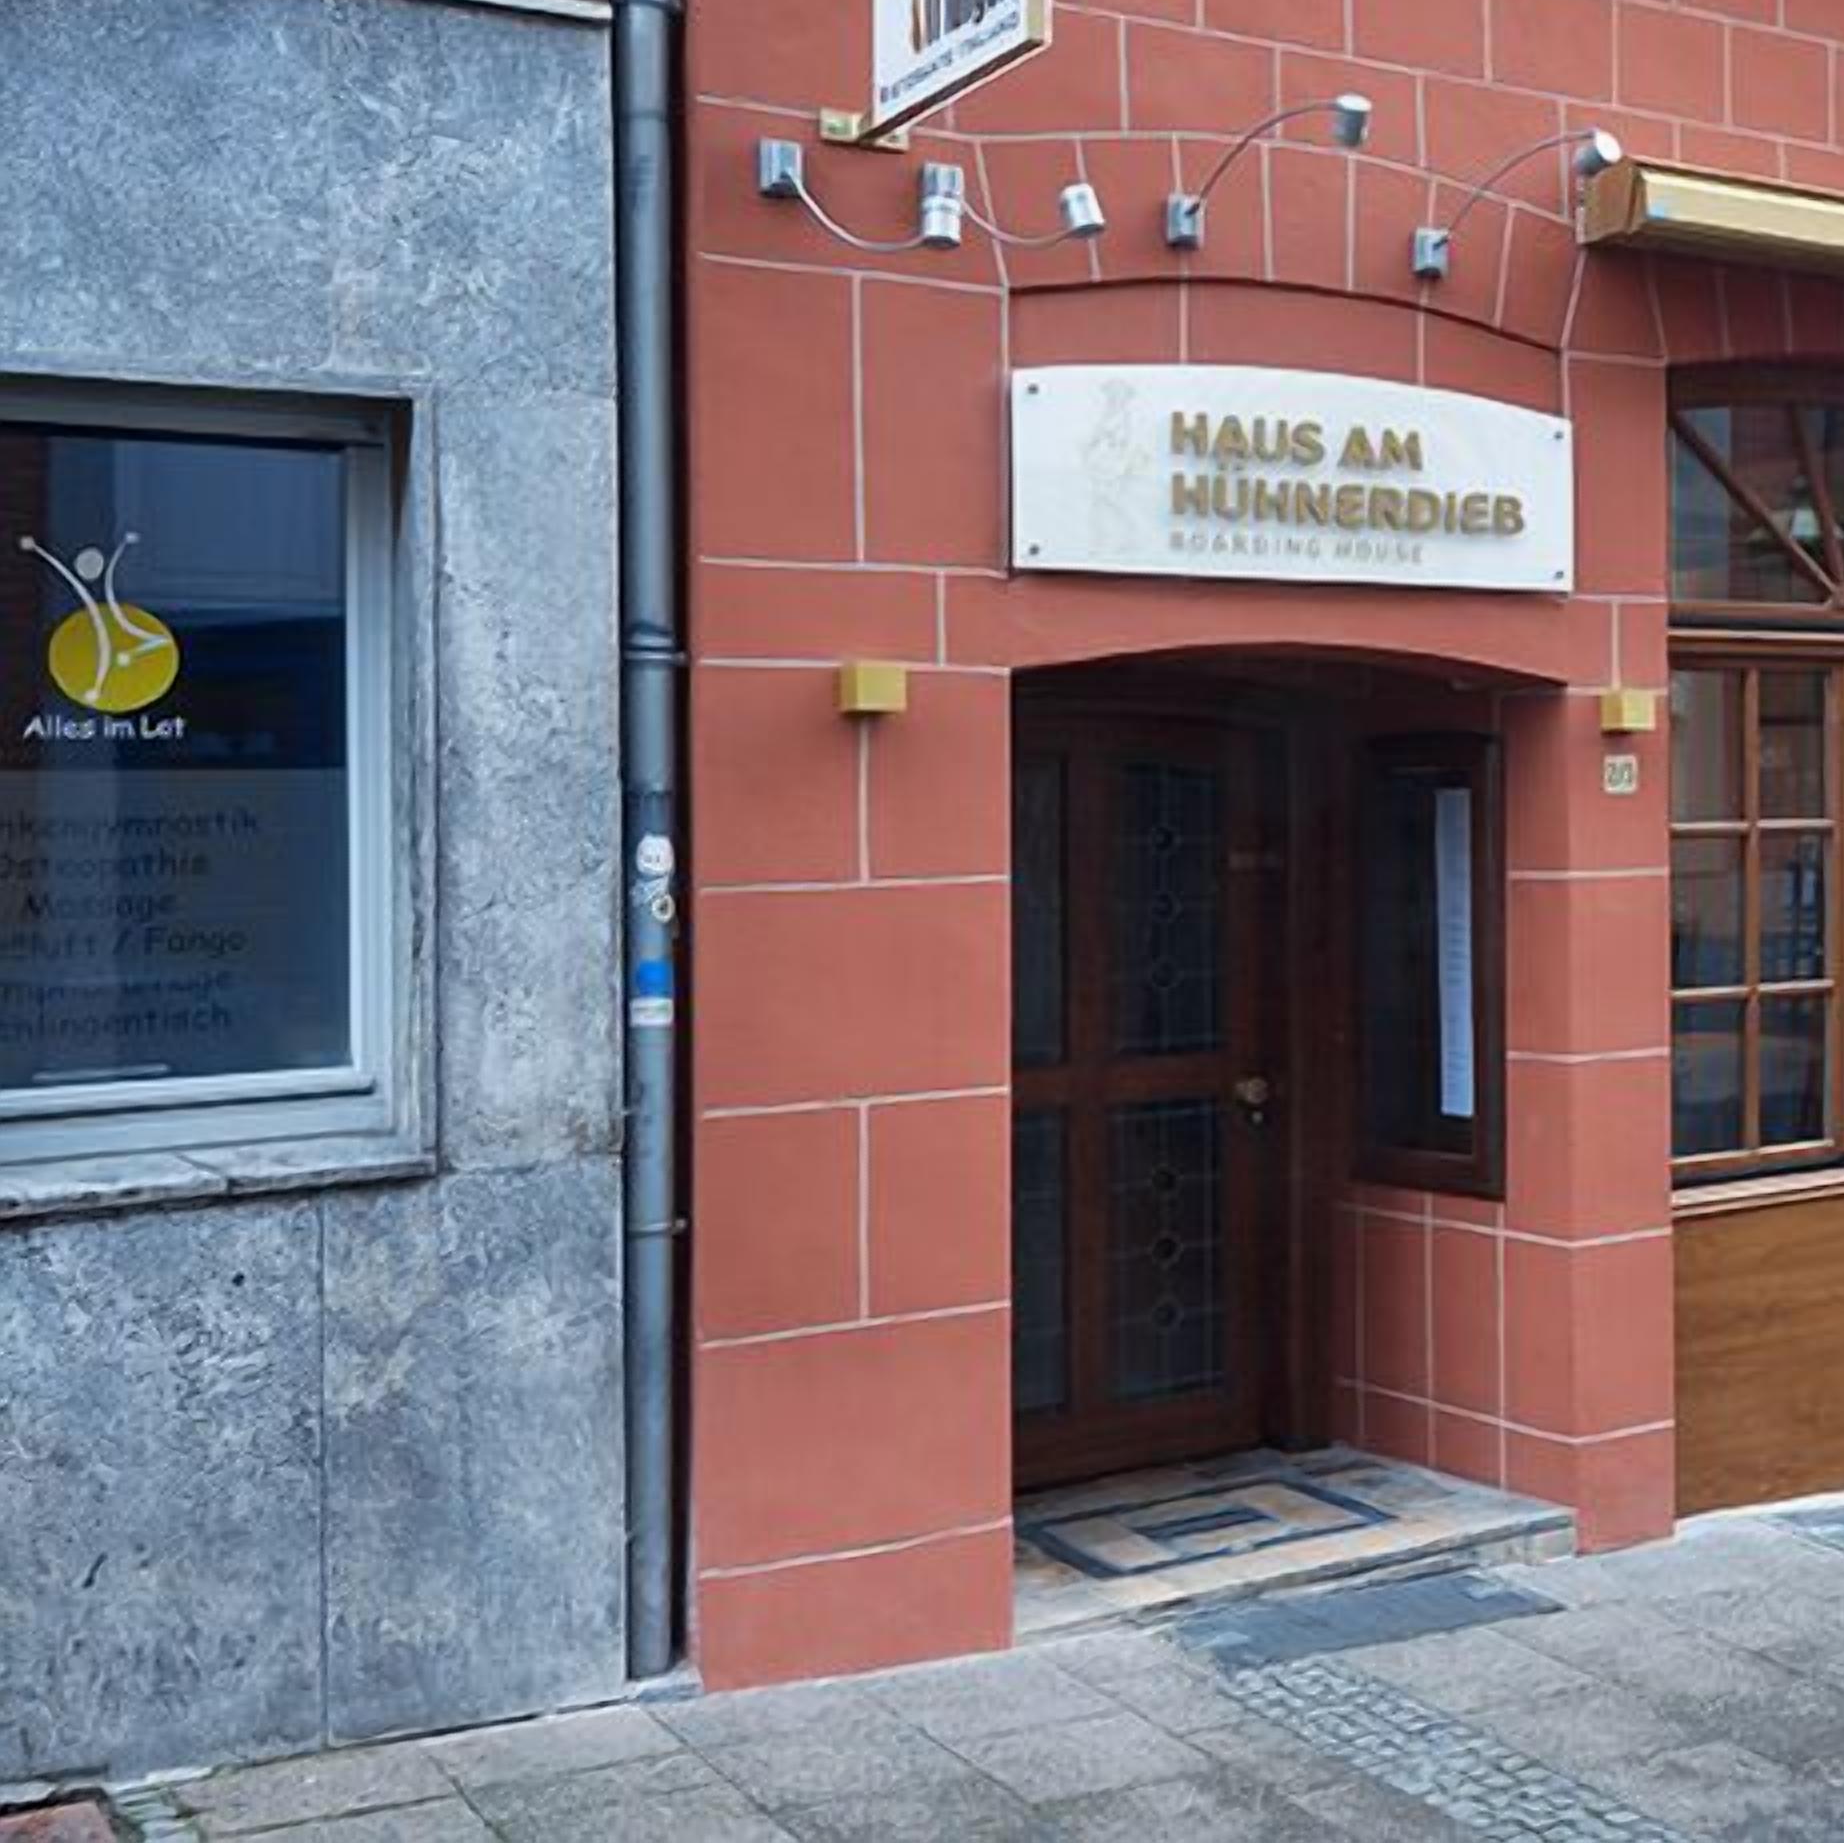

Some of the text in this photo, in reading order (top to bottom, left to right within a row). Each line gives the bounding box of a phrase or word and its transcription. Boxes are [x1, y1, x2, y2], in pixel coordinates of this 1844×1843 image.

[1170, 410, 1424, 473] HAUS AM
[1170, 467, 1525, 537] HÜHNERDIEB
[1169, 531, 1424, 566] BOARDING HOUSE
[22, 714, 187, 740] Alles im Lot
